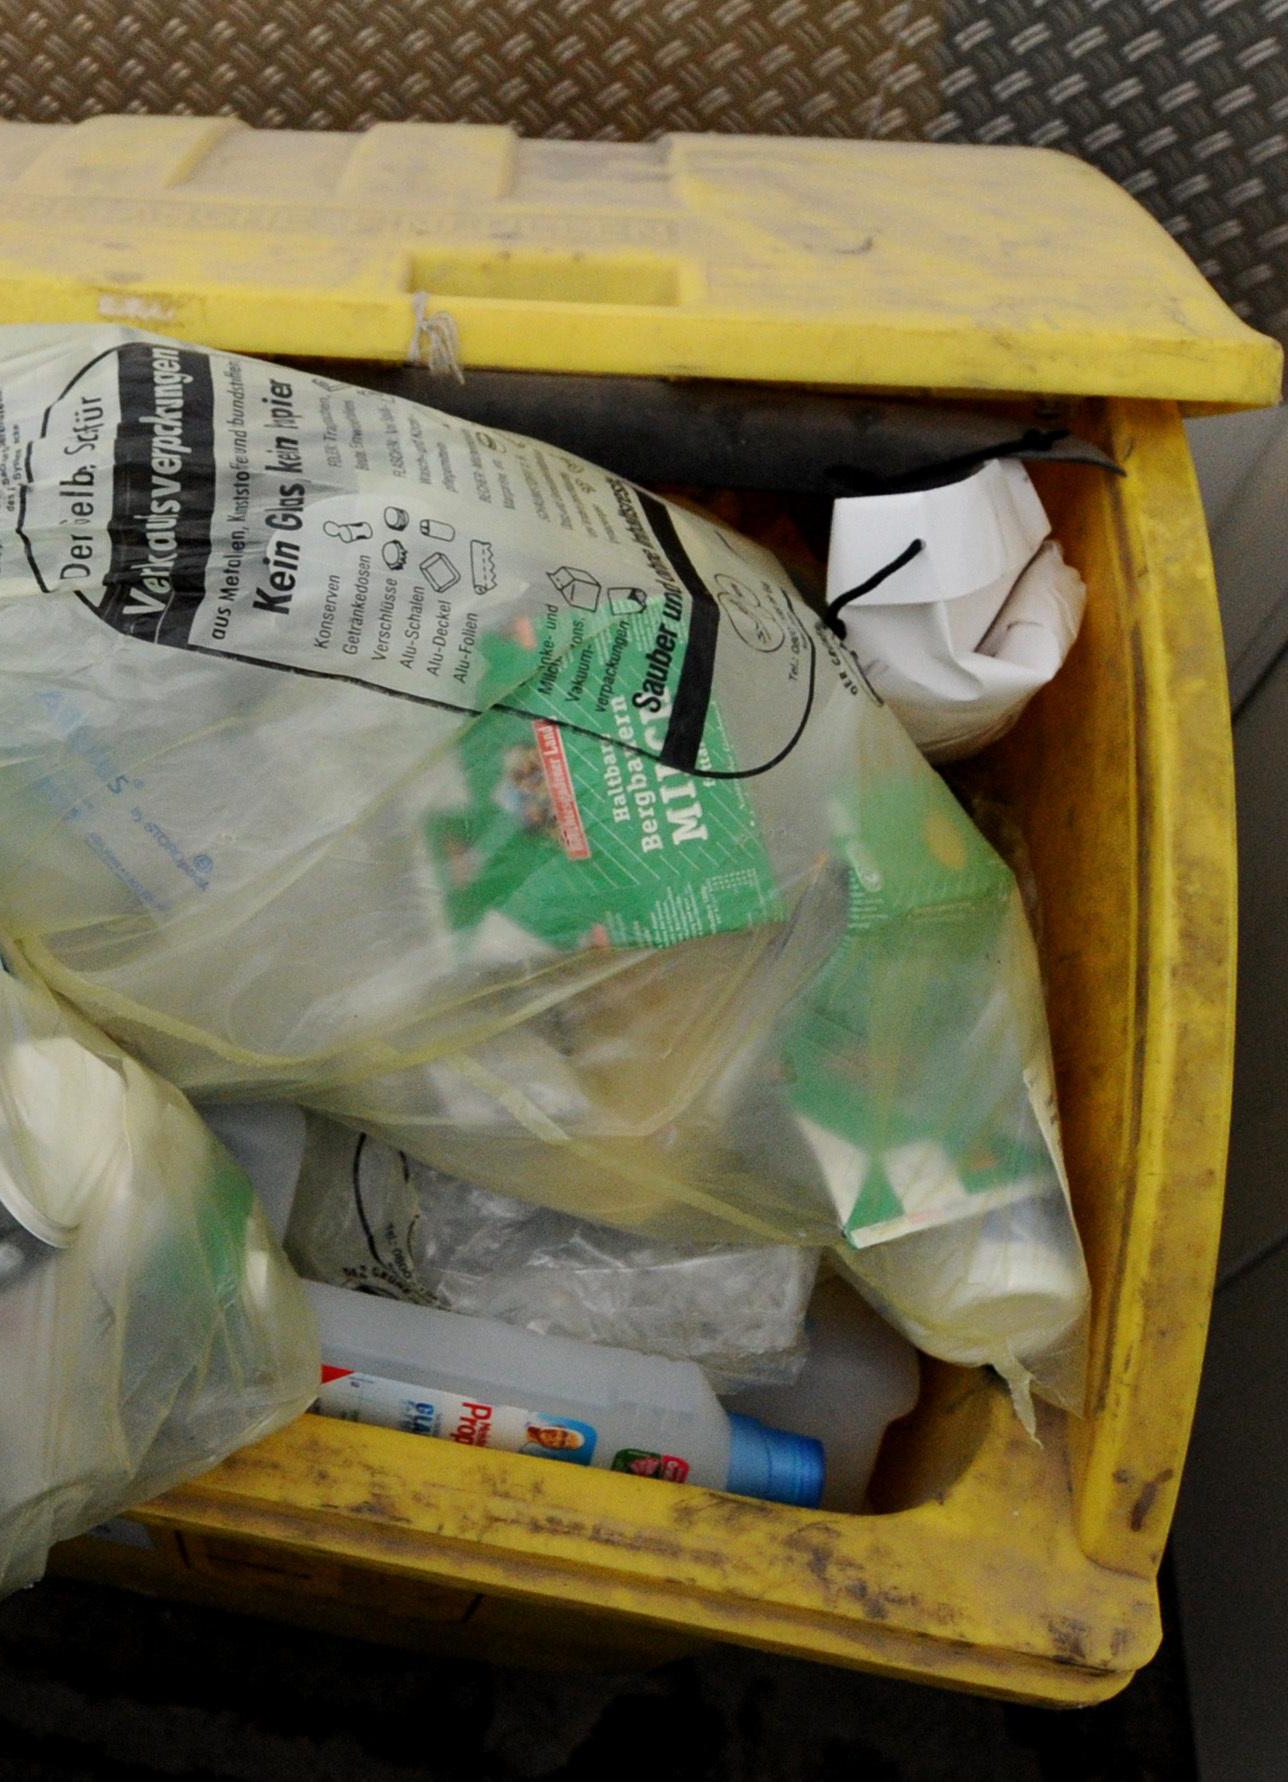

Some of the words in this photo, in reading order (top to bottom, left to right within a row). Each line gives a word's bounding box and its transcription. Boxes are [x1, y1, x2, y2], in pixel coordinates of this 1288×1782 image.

[59, 534, 94, 580] Der
[252, 540, 302, 616] Kein
[212, 606, 232, 640] aus
[312, 573, 341, 650] Konserven
[399, 584, 426, 671] Alu-Schalen
[426, 599, 453, 677] Alu-Deckel
[452, 611, 480, 685] Alu-Folien
[544, 602, 561, 632] und
[565, 642, 594, 703] Vakuum-
[595, 619, 631, 713] verpackungen
[631, 618, 678, 714] Sauber
